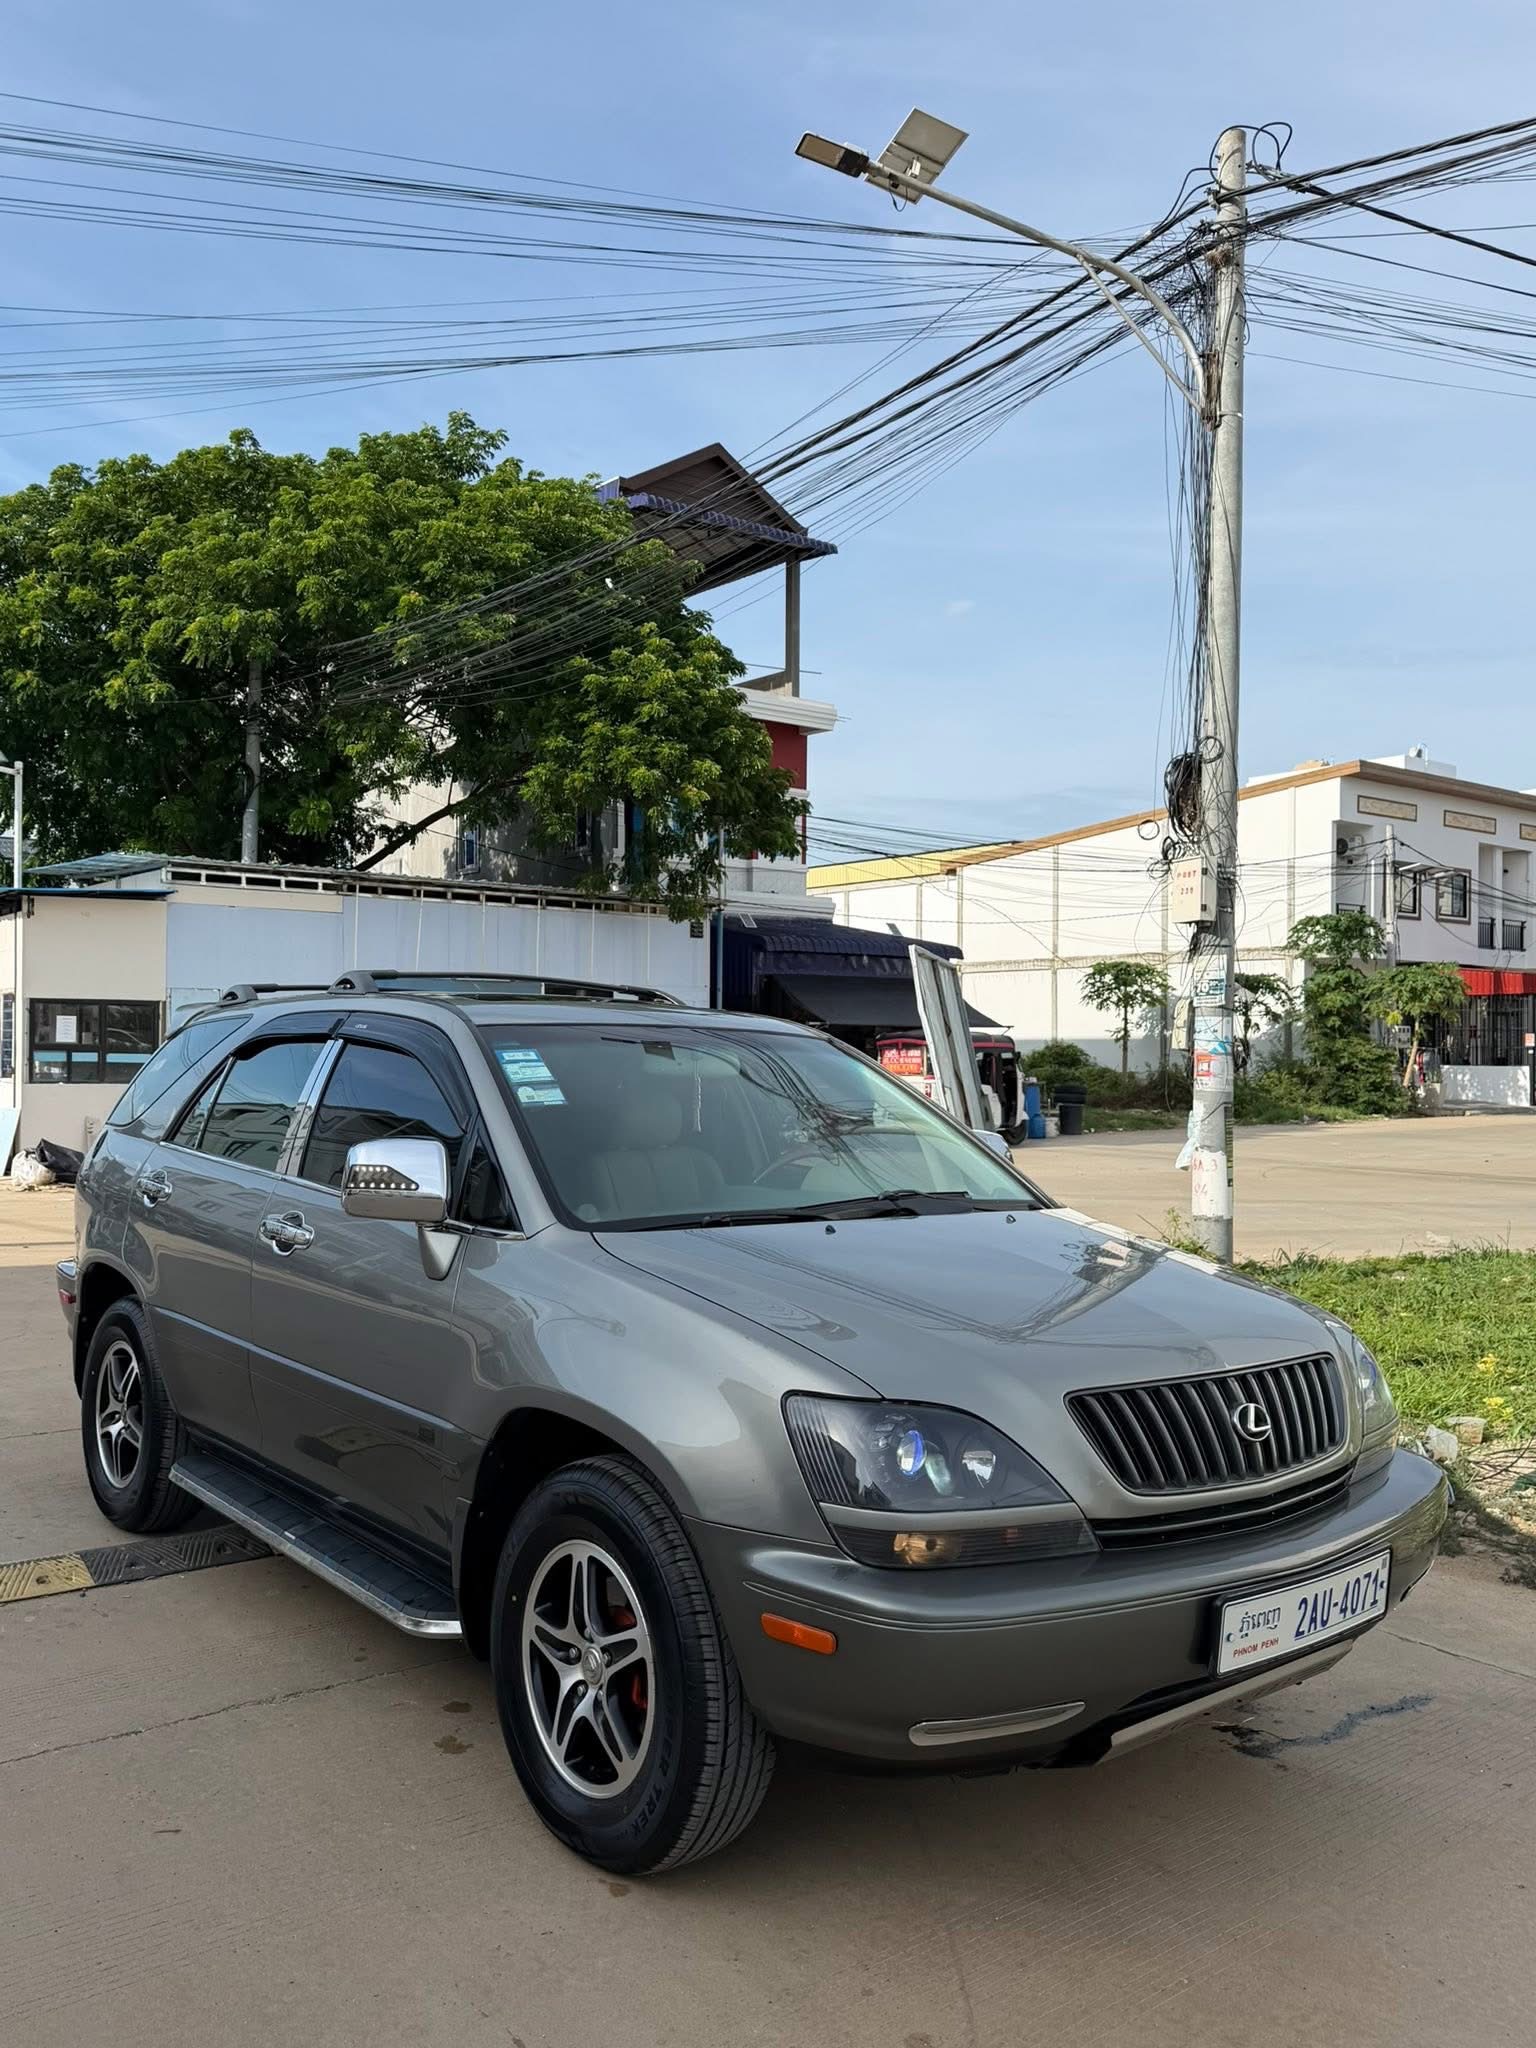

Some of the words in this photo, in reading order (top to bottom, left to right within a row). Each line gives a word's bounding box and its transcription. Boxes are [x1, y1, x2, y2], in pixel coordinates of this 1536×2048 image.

[1295, 1568, 1380, 1638] 2AU-4071
[1239, 1607, 1281, 1639] ភ្នំពេញ
[1233, 1643, 1258, 1658] PHNOM
[1261, 1637, 1280, 1649] PENH
